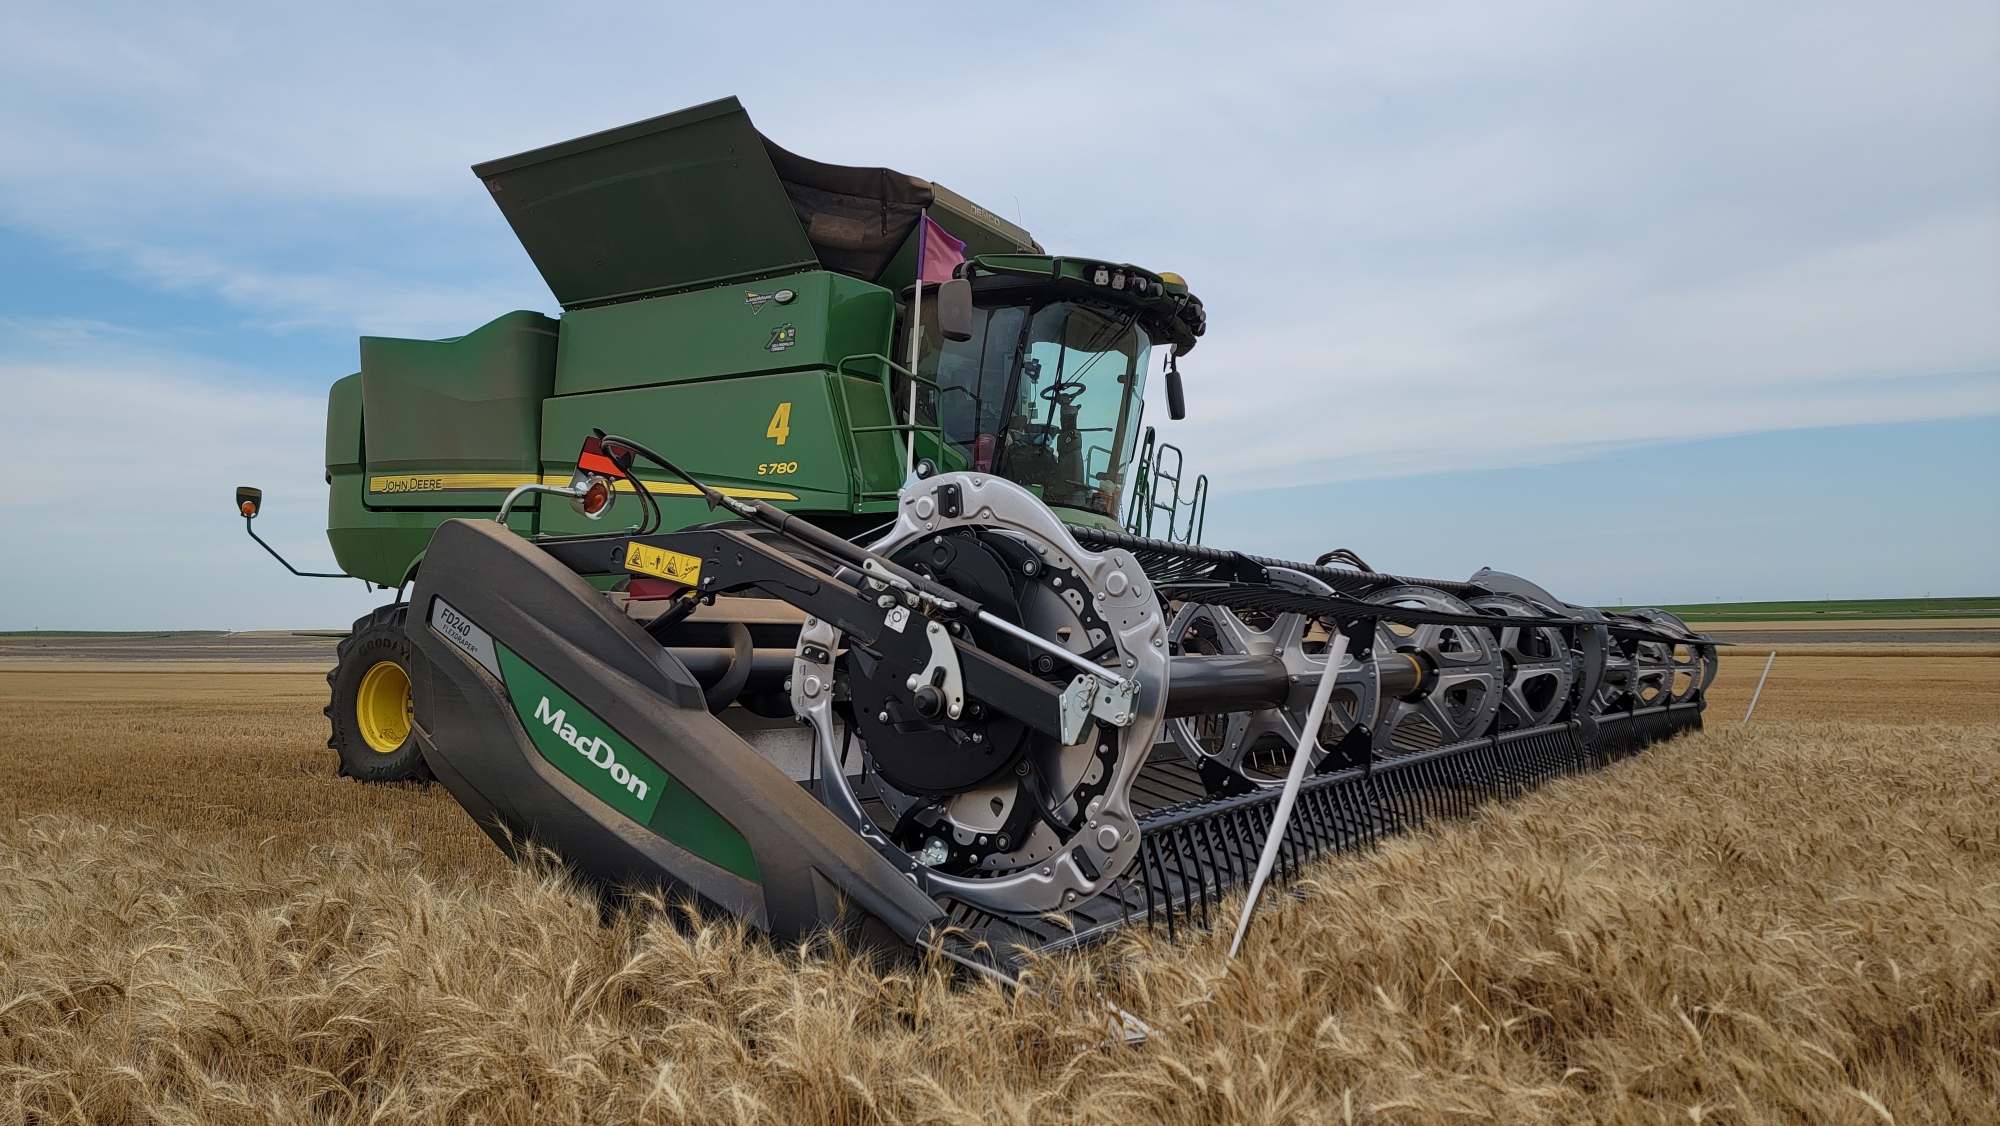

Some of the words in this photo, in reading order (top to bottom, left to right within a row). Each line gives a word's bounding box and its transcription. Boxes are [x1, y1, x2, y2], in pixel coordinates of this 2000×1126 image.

[970, 204, 1001, 227] DEMCO
[766, 402, 792, 446] 4
[757, 461, 798, 476] S780
[382, 479, 408, 492] JOHN
[409, 478, 443, 490] DEERE
[440, 607, 471, 637] FD240
[533, 695, 649, 801] MacDon
